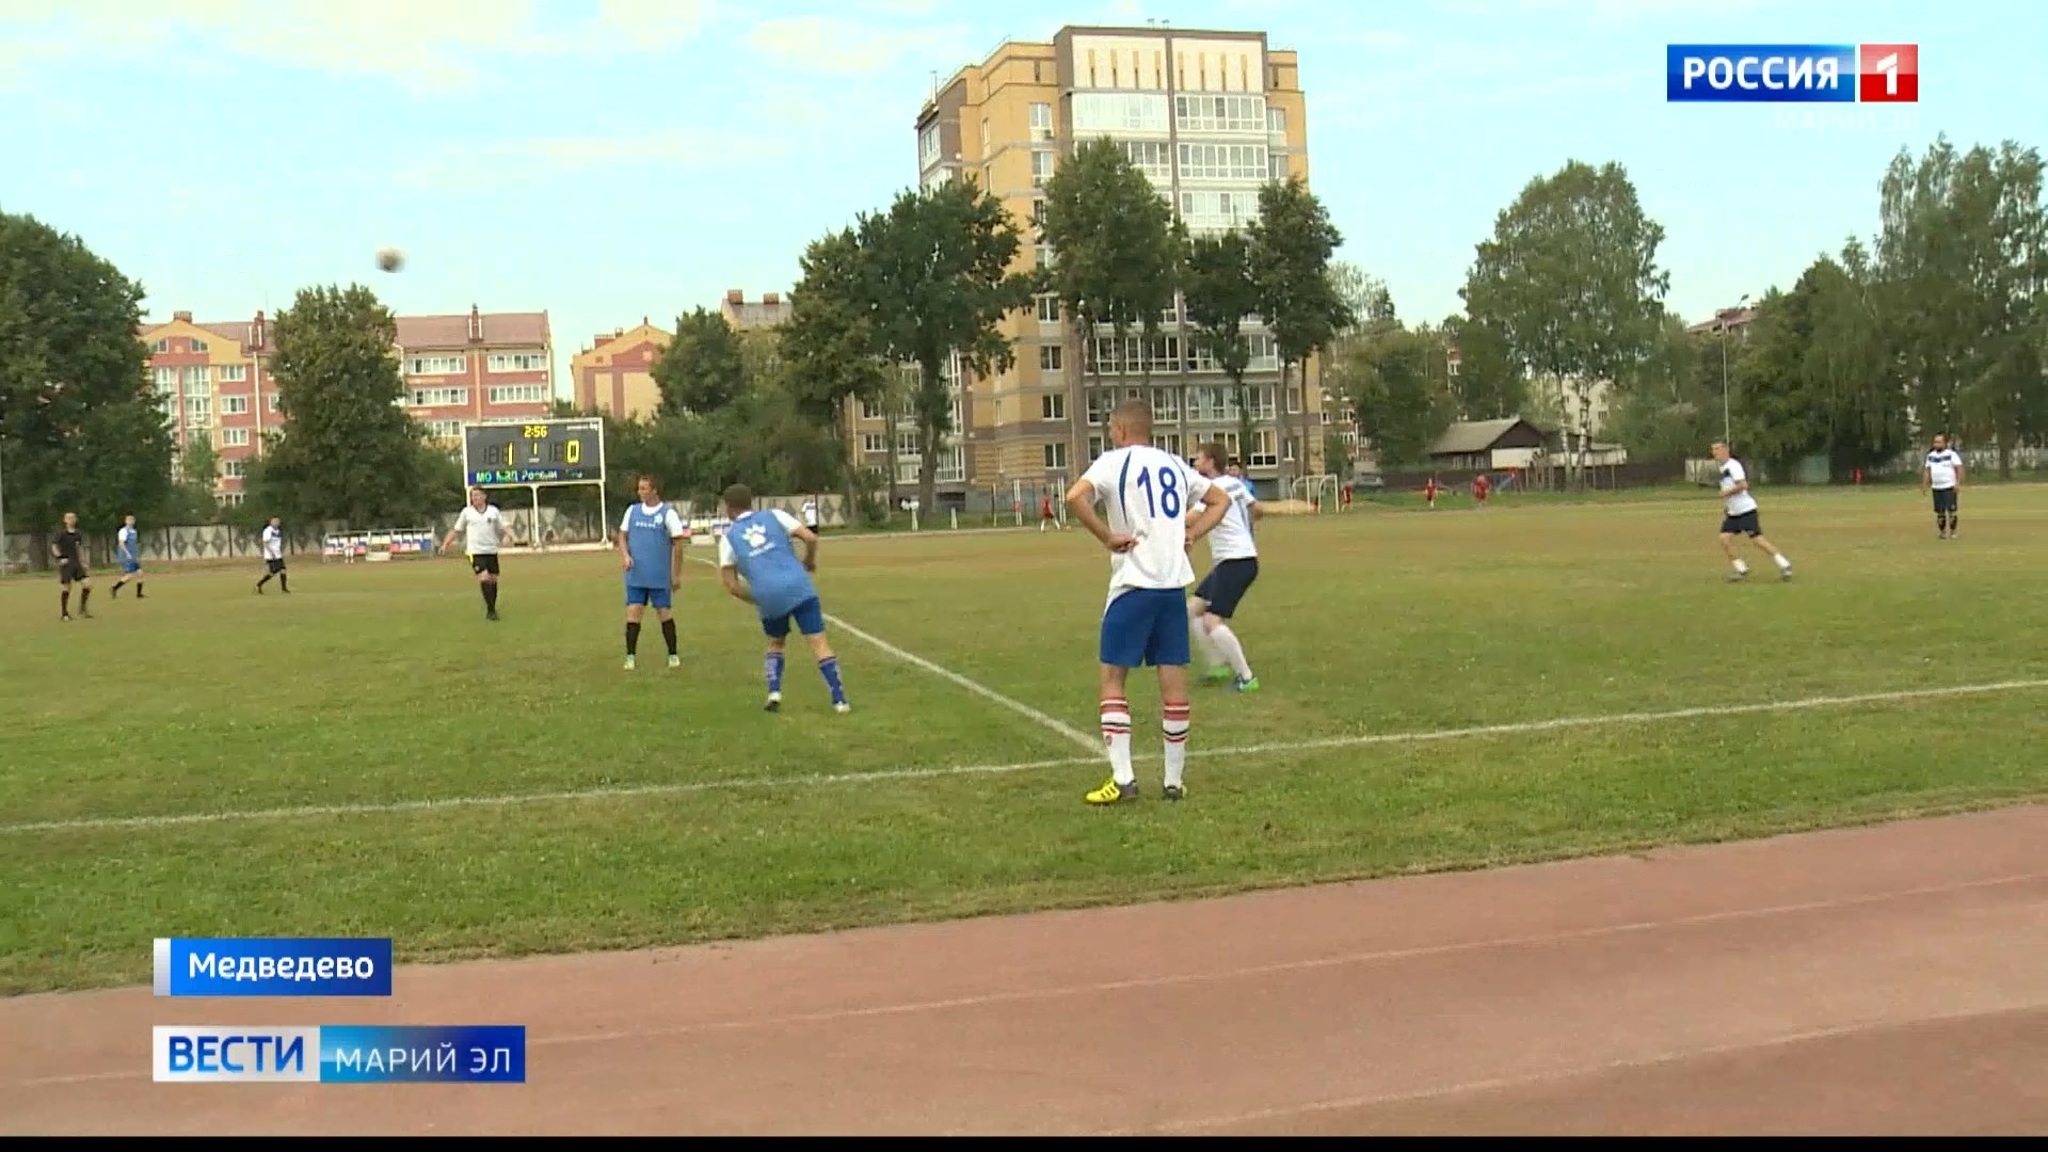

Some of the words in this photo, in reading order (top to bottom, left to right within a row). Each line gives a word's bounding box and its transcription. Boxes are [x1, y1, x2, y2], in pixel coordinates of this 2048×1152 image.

[524, 426, 547, 438] 2:56
[567, 440, 580, 463] 0
[1137, 466, 1179, 519] 18
